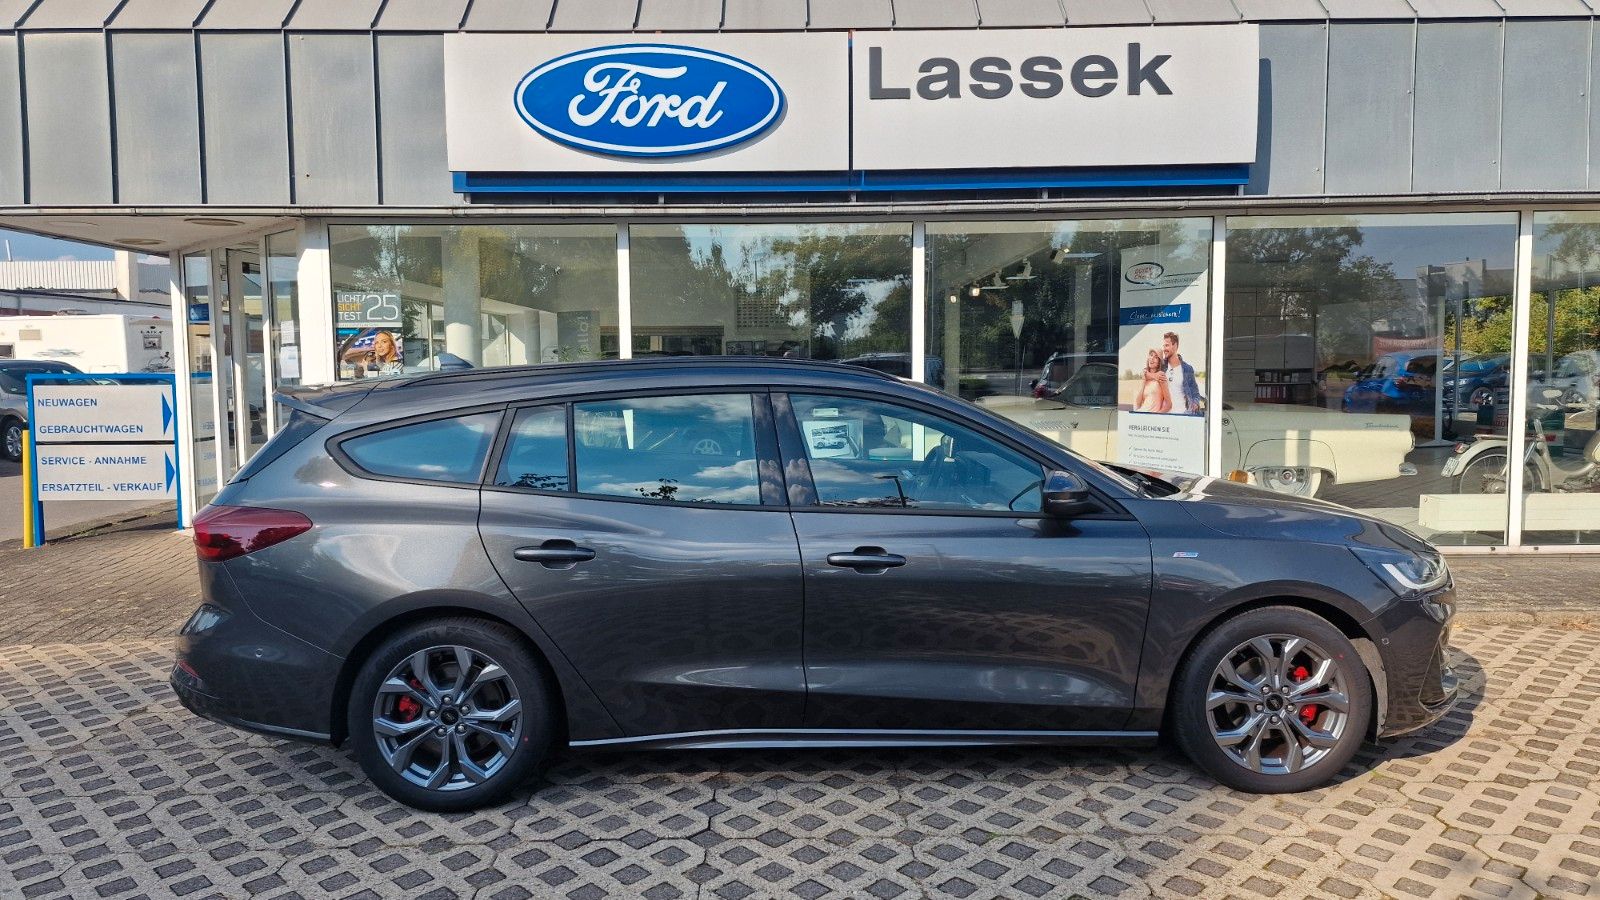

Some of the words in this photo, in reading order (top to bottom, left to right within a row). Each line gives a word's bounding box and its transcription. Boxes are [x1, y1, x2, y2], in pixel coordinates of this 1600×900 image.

[868, 42, 1173, 100] Lassek
[568, 62, 728, 128] Ford
[337, 294, 361, 303] LICHT
[337, 303, 361, 311] SICHT
[338, 311, 362, 320] TEST
[37, 398, 98, 407] NEUWAGEN
[39, 425, 144, 434] GEBRAUCHTWAGEN
[41, 457, 85, 465] SERVICE
[95, 456, 147, 465] ANNAHME
[42, 483, 104, 492] ERSATZTEIL
[113, 482, 164, 492] VERKAUF
